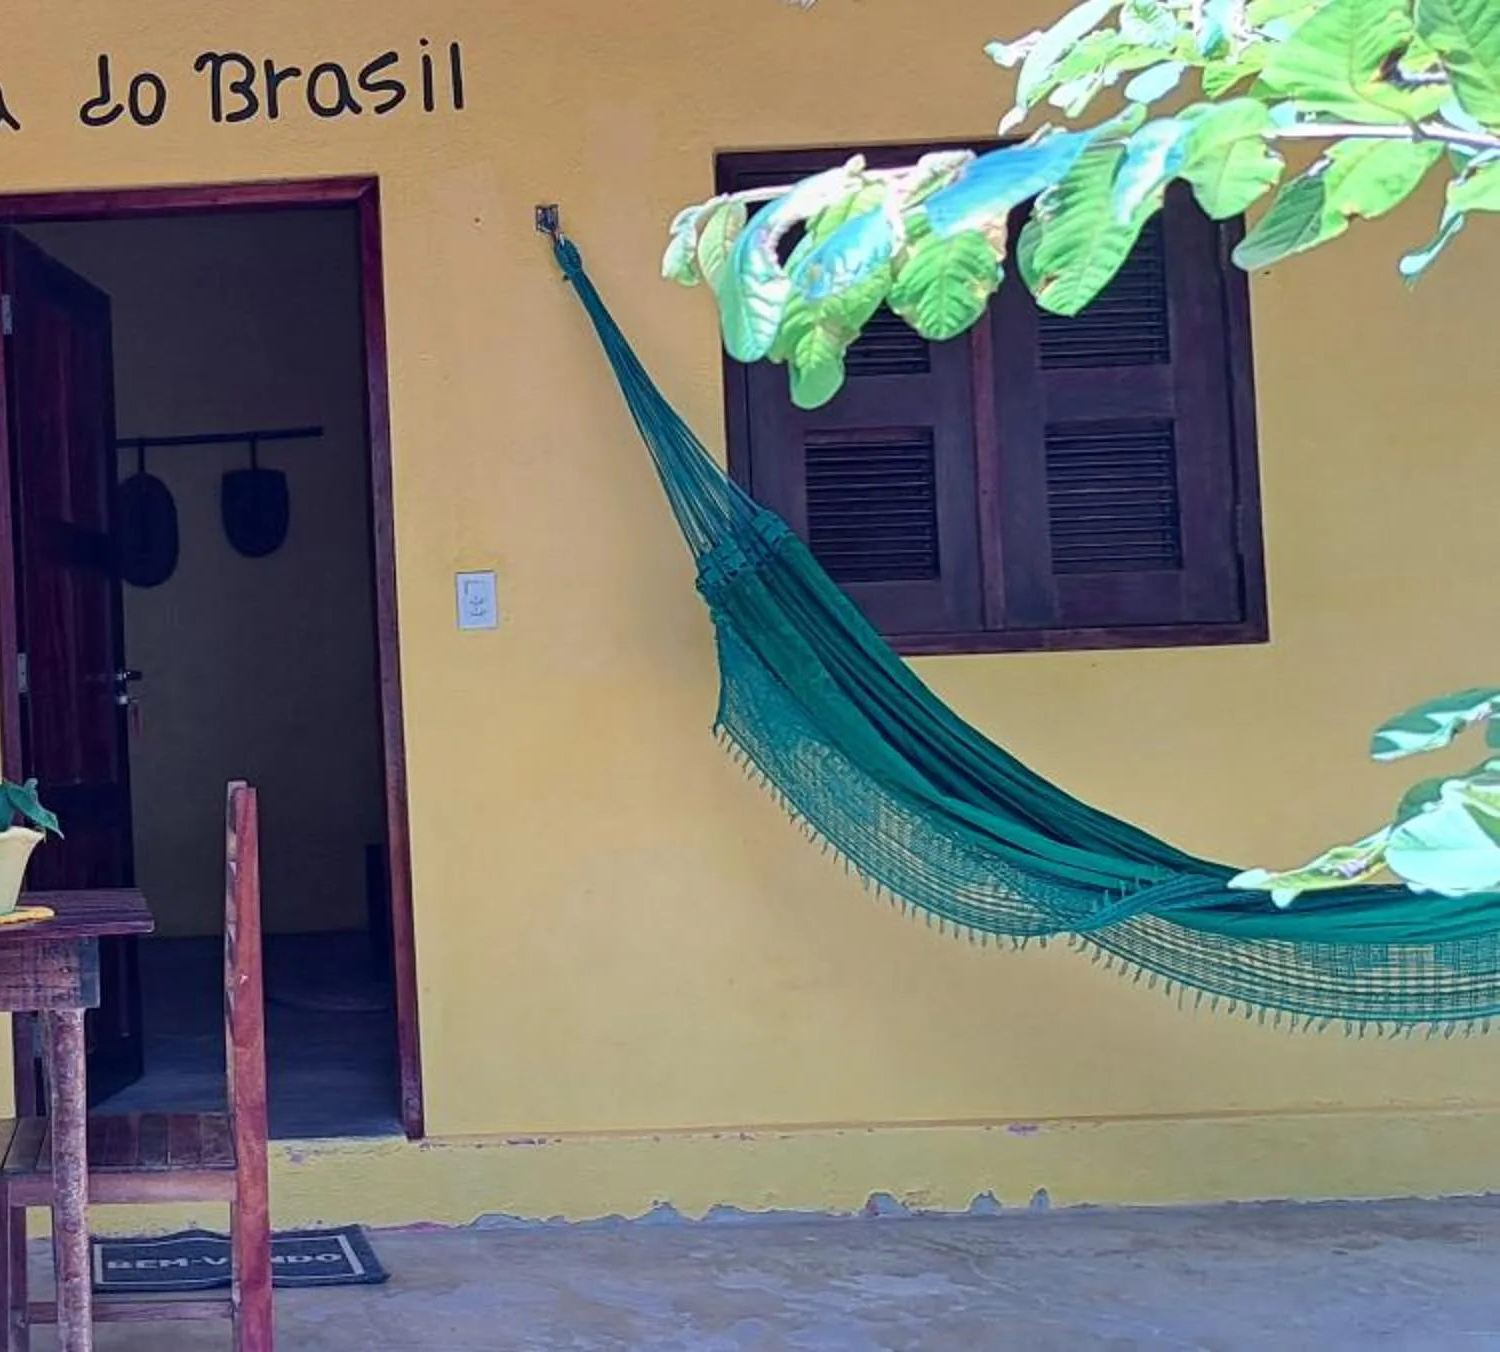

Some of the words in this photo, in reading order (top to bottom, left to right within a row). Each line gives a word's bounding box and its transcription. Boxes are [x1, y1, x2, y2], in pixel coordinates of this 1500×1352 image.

[79, 53, 167, 127] do
[194, 38, 465, 123] Brasil
[107, 1253, 342, 1269] BEM-VNDO
